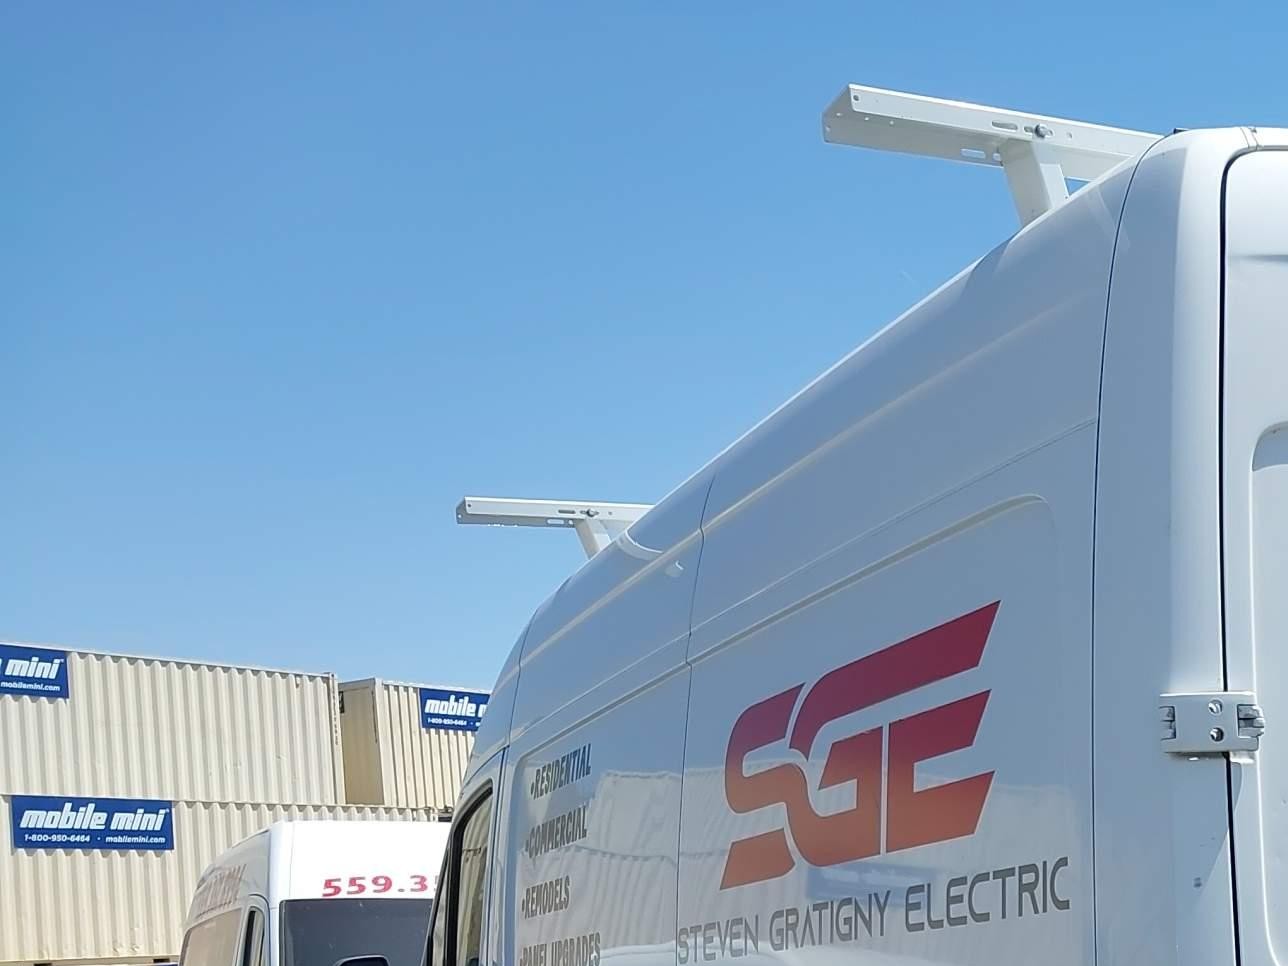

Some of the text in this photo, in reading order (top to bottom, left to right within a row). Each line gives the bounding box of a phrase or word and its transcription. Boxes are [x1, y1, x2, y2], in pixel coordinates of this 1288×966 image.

[5, 657, 61, 679] mini
[425, 695, 476, 717] mobile
[720, 600, 1001, 890] SGE
[20, 803, 165, 831] mobile mini
[106, 835, 165, 843] mobilemini.com
[678, 857, 1070, 965] STEVEN GRATIGNY ELECTRIC
